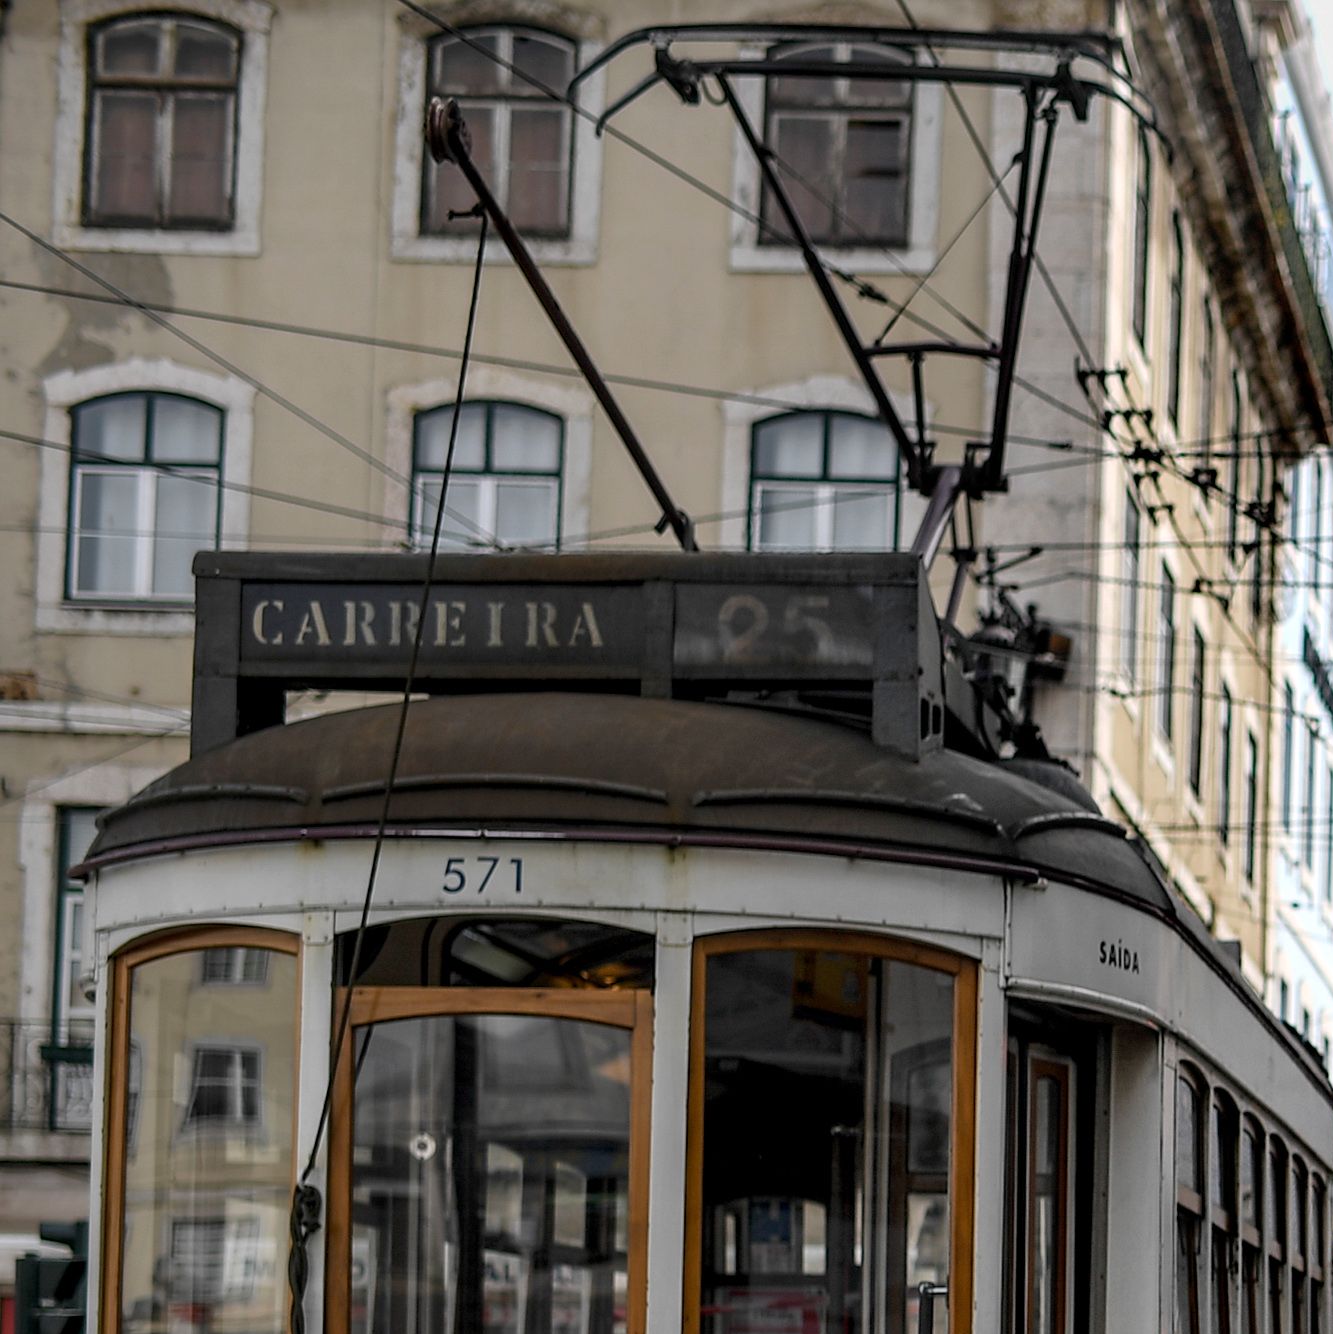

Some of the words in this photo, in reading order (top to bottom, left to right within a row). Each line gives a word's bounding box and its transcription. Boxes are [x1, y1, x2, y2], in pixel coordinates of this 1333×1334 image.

[251, 598, 606, 649] CARREIRA
[718, 593, 834, 664] 25
[442, 856, 525, 896] 571
[1099, 938, 1140, 975] SAÍDA
